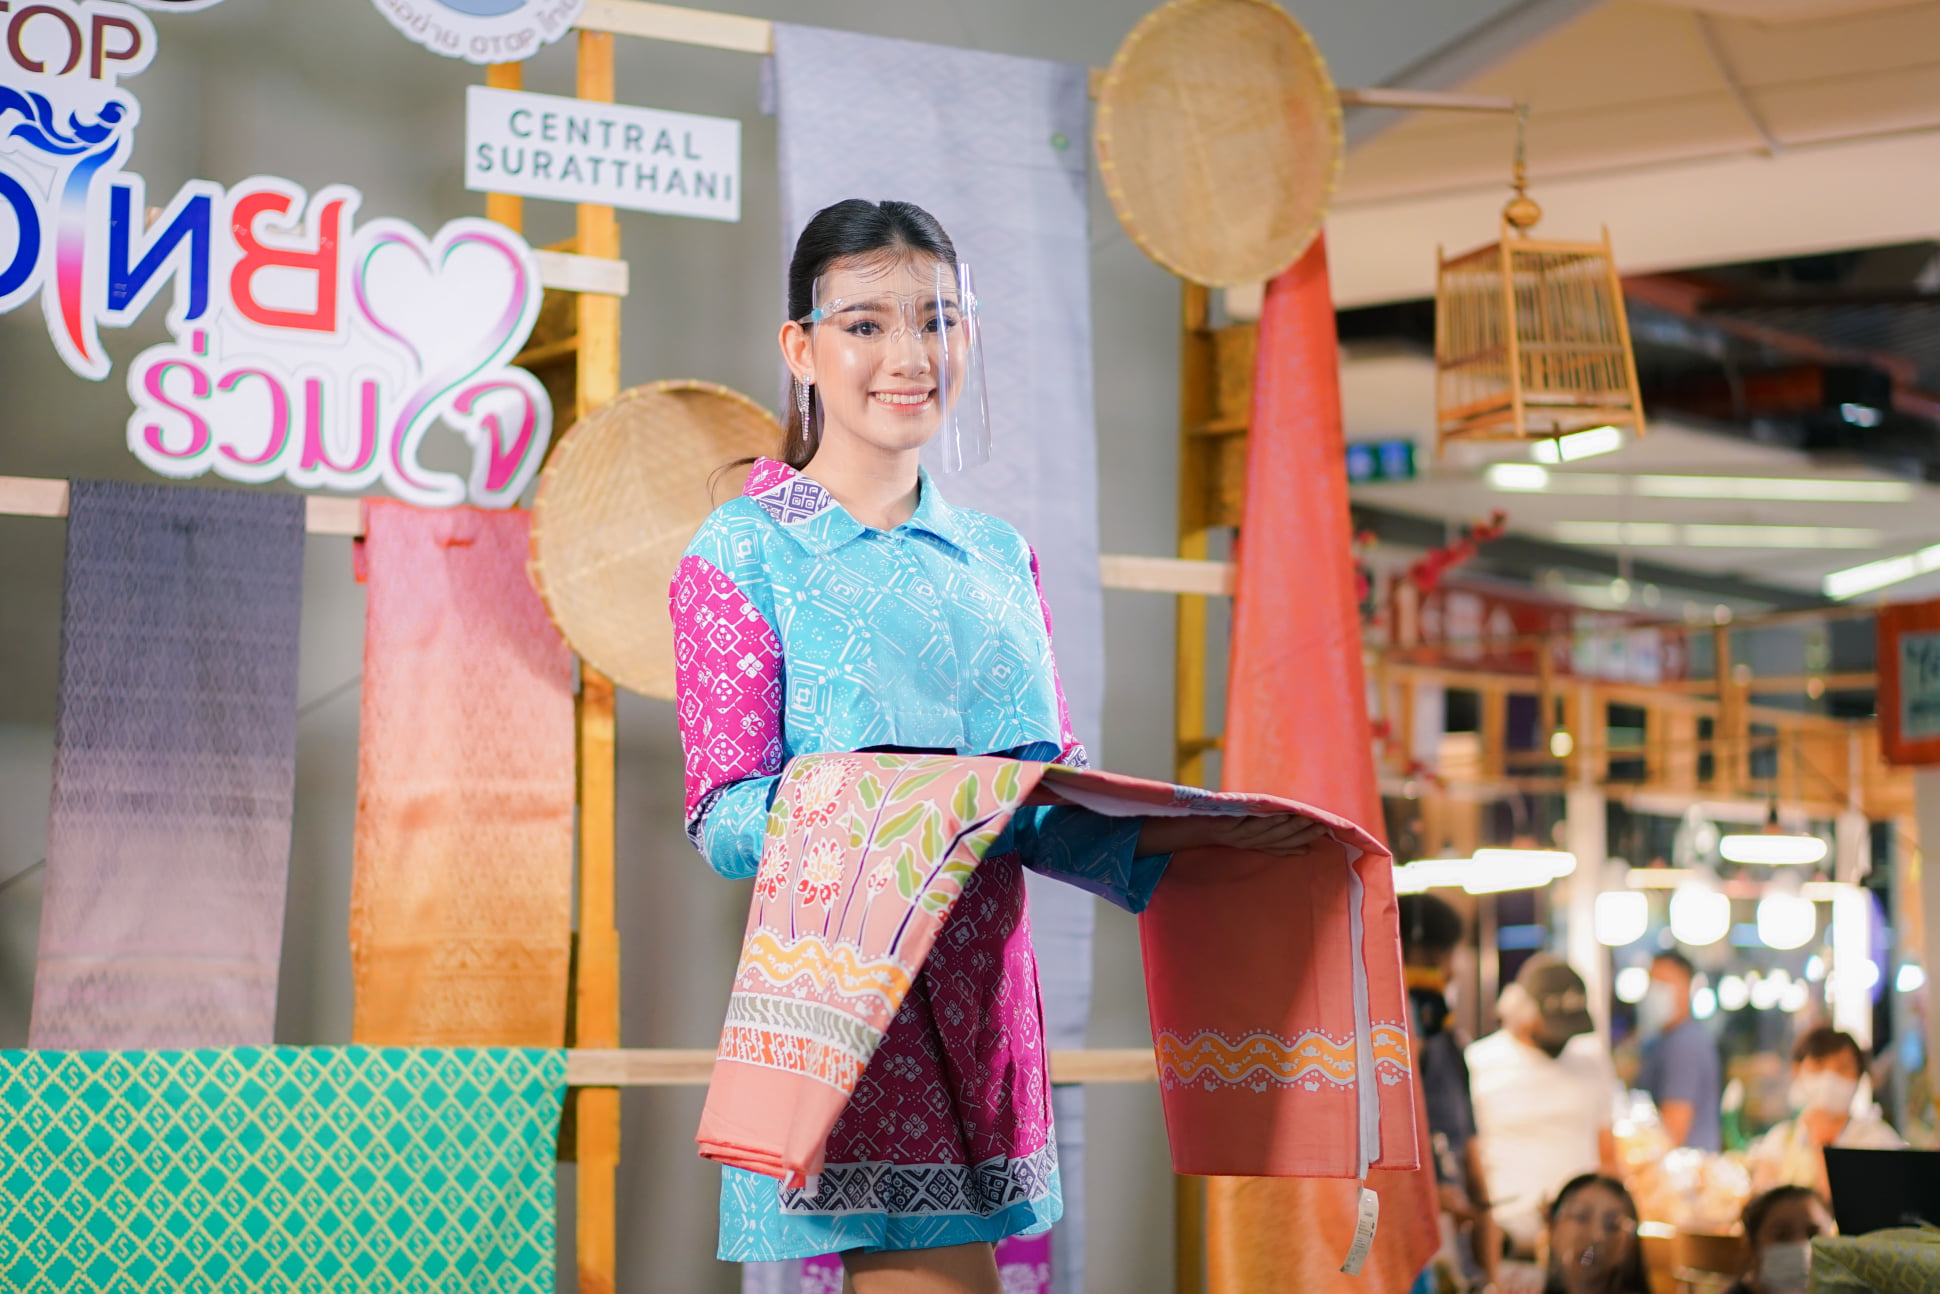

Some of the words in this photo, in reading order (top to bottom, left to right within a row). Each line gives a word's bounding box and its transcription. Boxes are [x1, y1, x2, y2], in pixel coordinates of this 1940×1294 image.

[0, 1, 142, 80] OP
[469, 27, 536, 55] OTOP
[508, 109, 702, 160] CENTRAL
[476, 143, 732, 202] SURATTHANI
